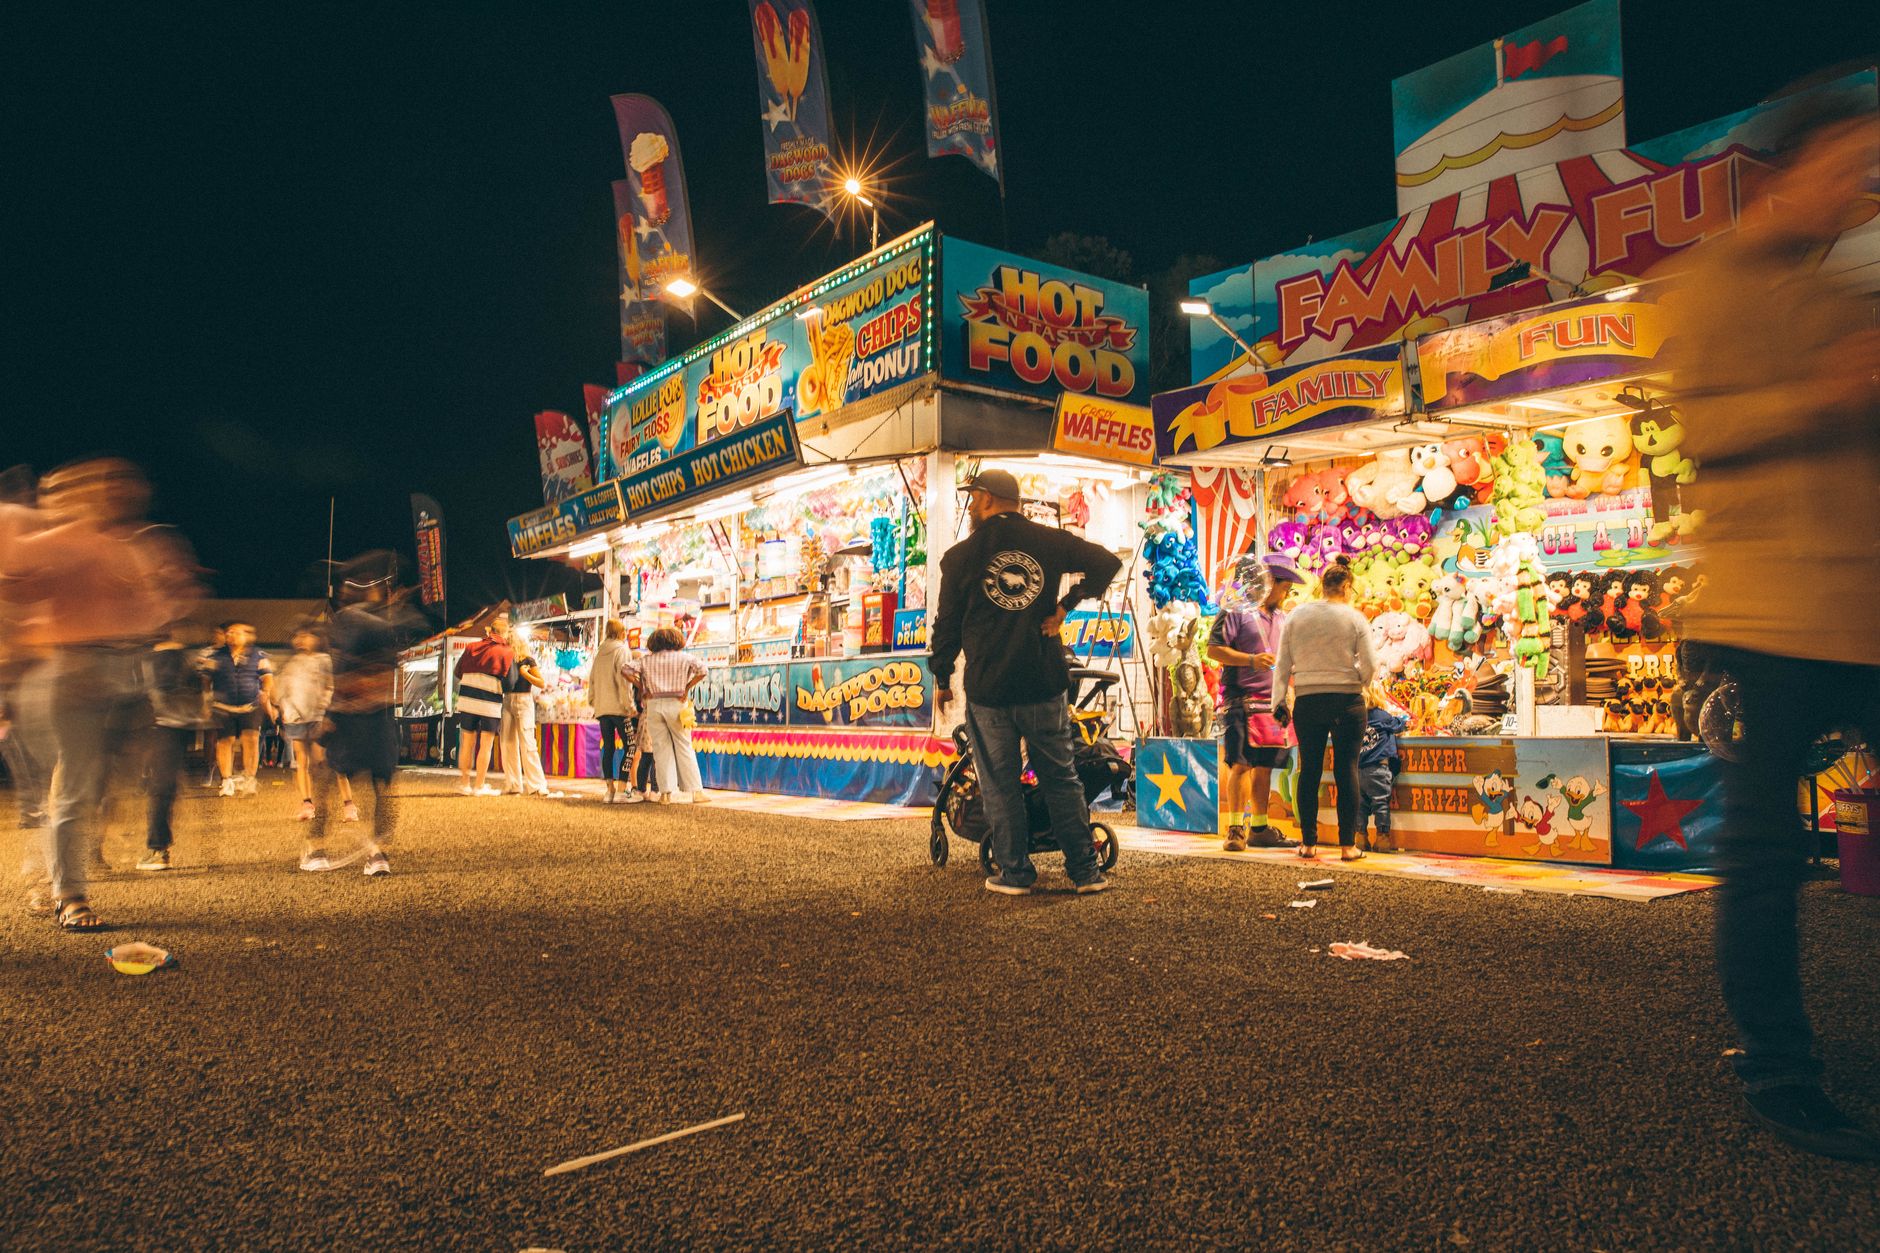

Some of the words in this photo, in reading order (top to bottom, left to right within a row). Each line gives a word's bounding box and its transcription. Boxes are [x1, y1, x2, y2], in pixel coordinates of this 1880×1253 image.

[770, 143, 829, 170] DAGWOOD
[784, 162, 816, 184] DOGS
[999, 265, 1104, 329] HOT
[1281, 208, 1569, 345] FAMILY
[822, 278, 884, 331] DAGWOOD
[856, 292, 922, 359] CHIPS
[1028, 319, 1097, 347] TASTY
[1518, 313, 1637, 361] FUN
[711, 327, 768, 385] HOT
[729, 364, 766, 392] TASTY
[967, 318, 1136, 398] FOOD
[632, 390, 658, 427] LOLLIE
[658, 375, 684, 411] POPS
[697, 372, 783, 446] FOOD
[1252, 368, 1393, 427] FAMILY
[620, 431, 641, 459] FAIRY
[643, 411, 671, 442] FLOSS
[1063, 411, 1154, 452] WAFFLES
[623, 446, 662, 476] WAFFLES
[690, 452, 721, 487] HOT
[720, 425, 788, 476] CHICKEN
[626, 481, 651, 511] HOT
[650, 466, 687, 501] CHIPS
[515, 513, 577, 554] WAFFLES
[1592, 521, 1612, 552] A
[990, 583, 1041, 608] WESTERN
[1082, 618, 1131, 644] FOOD
[723, 671, 781, 713] DRINKS
[796, 662, 922, 712] DAGWOOD
[849, 685, 924, 721] DOGS
[1411, 787, 1469, 813] PRIZE
